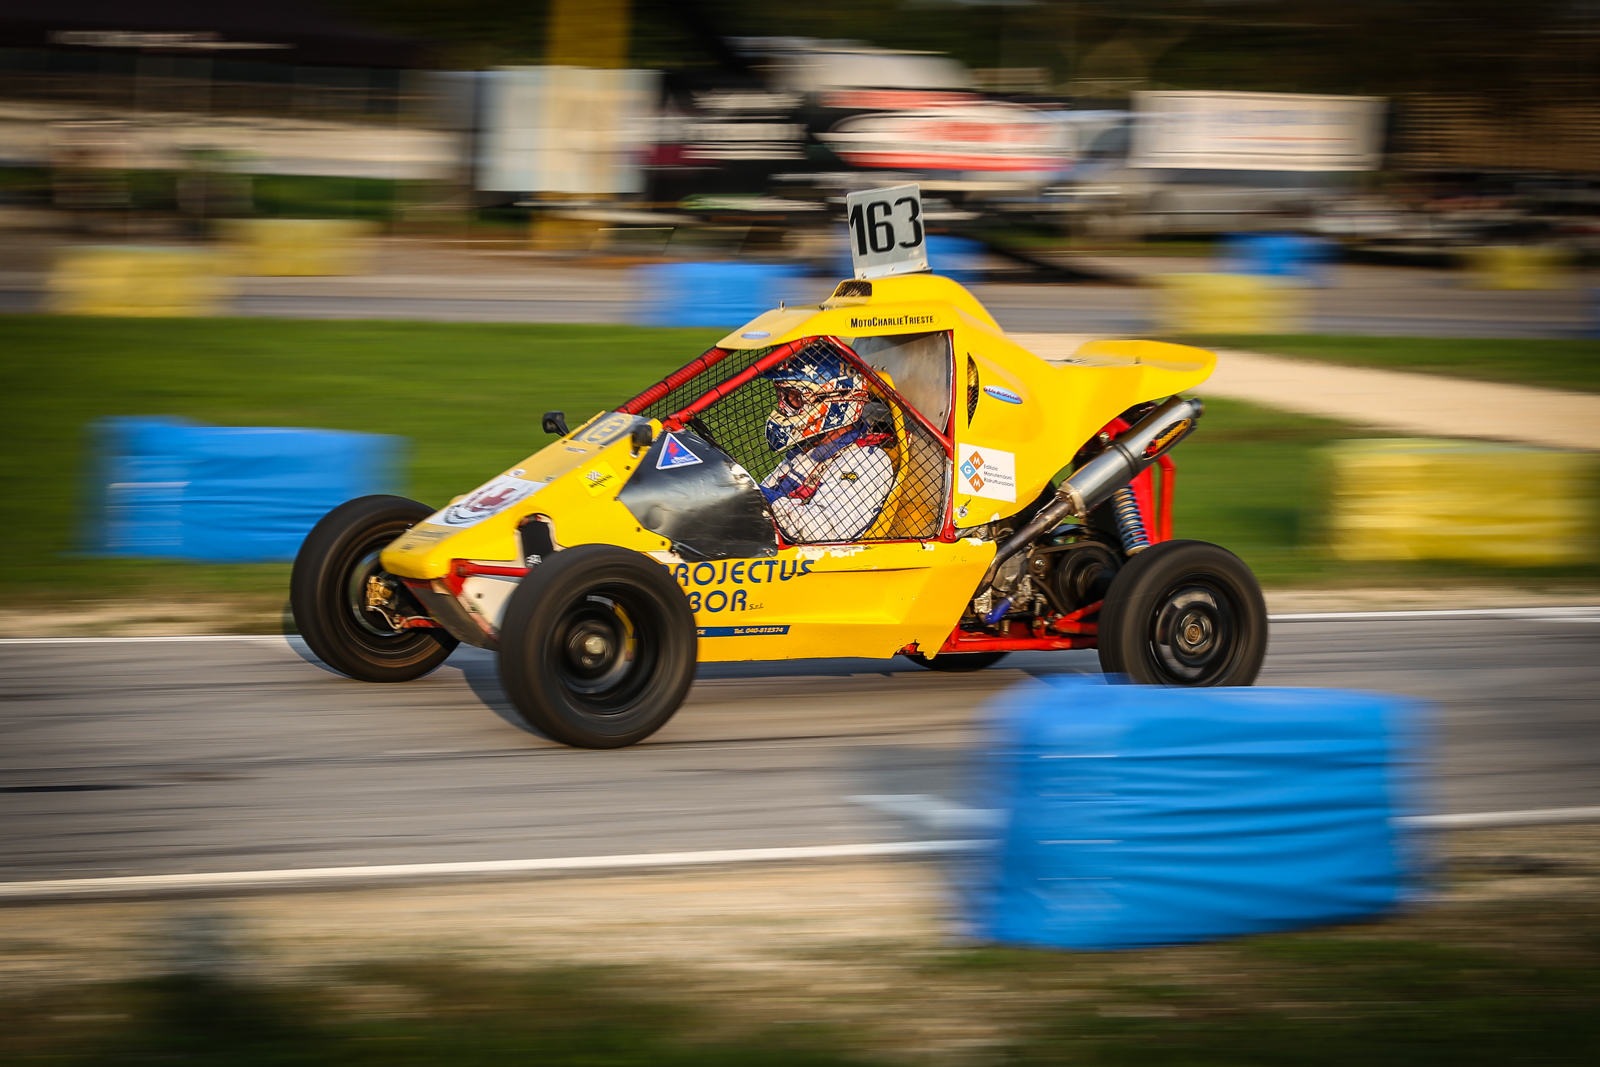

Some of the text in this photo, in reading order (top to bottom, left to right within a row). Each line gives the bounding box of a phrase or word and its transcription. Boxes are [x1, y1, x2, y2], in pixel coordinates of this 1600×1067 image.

[849, 196, 923, 256] 163
[973, 456, 981, 466] M
[963, 465, 972, 475] G
[973, 478, 981, 488] M
[662, 560, 815, 587] ROJECTUS
[687, 589, 748, 614] BOR
